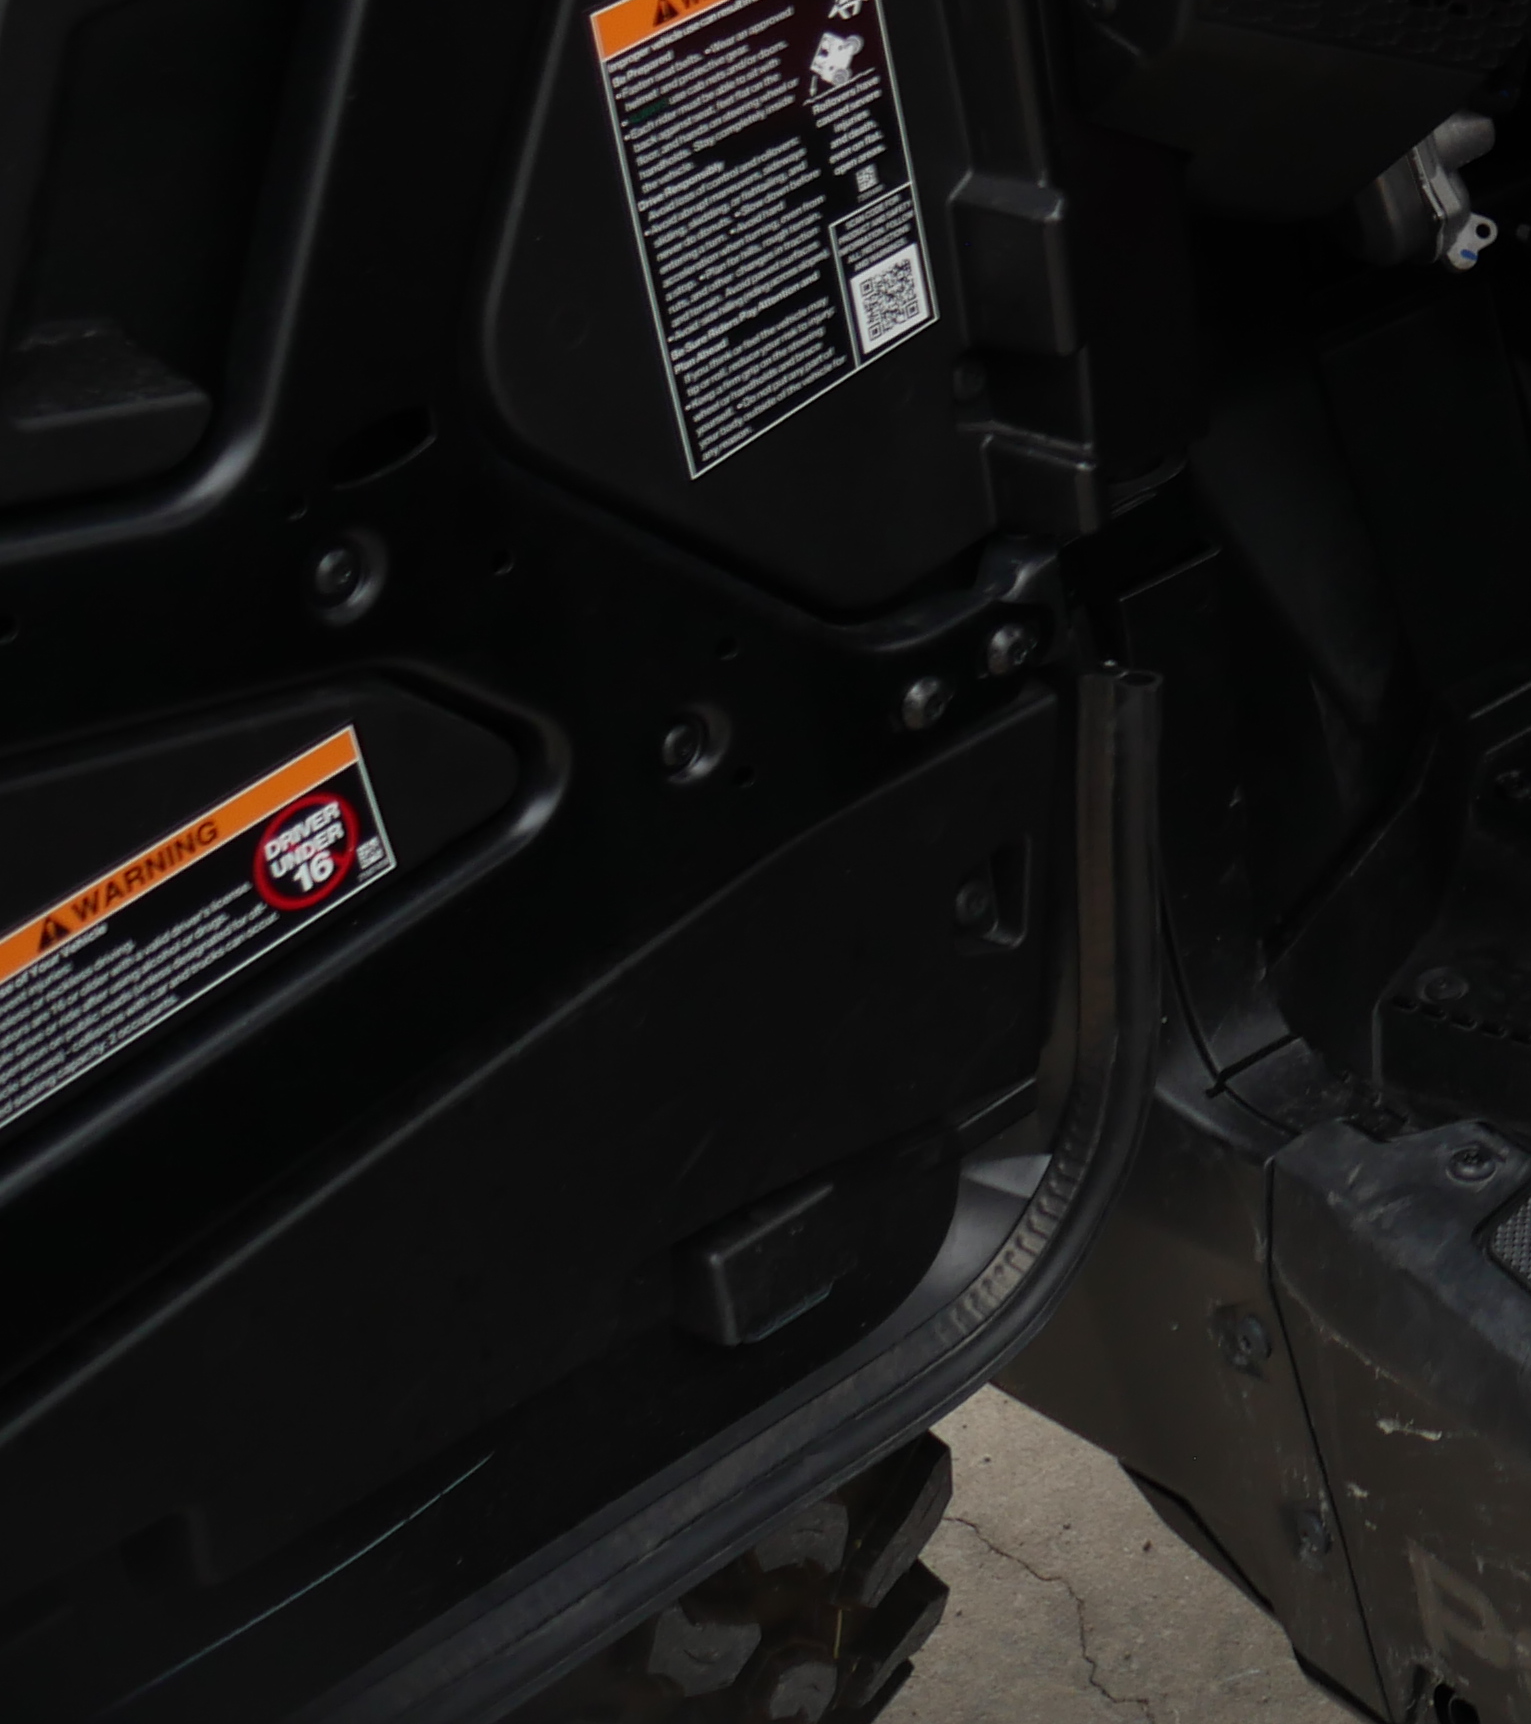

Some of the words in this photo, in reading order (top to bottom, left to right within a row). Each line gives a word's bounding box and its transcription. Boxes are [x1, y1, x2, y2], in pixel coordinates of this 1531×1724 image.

[264, 800, 342, 862] DRIVER
[270, 822, 345, 880] UNDER
[72, 819, 219, 922] WARNING
[293, 853, 335, 893] 16
